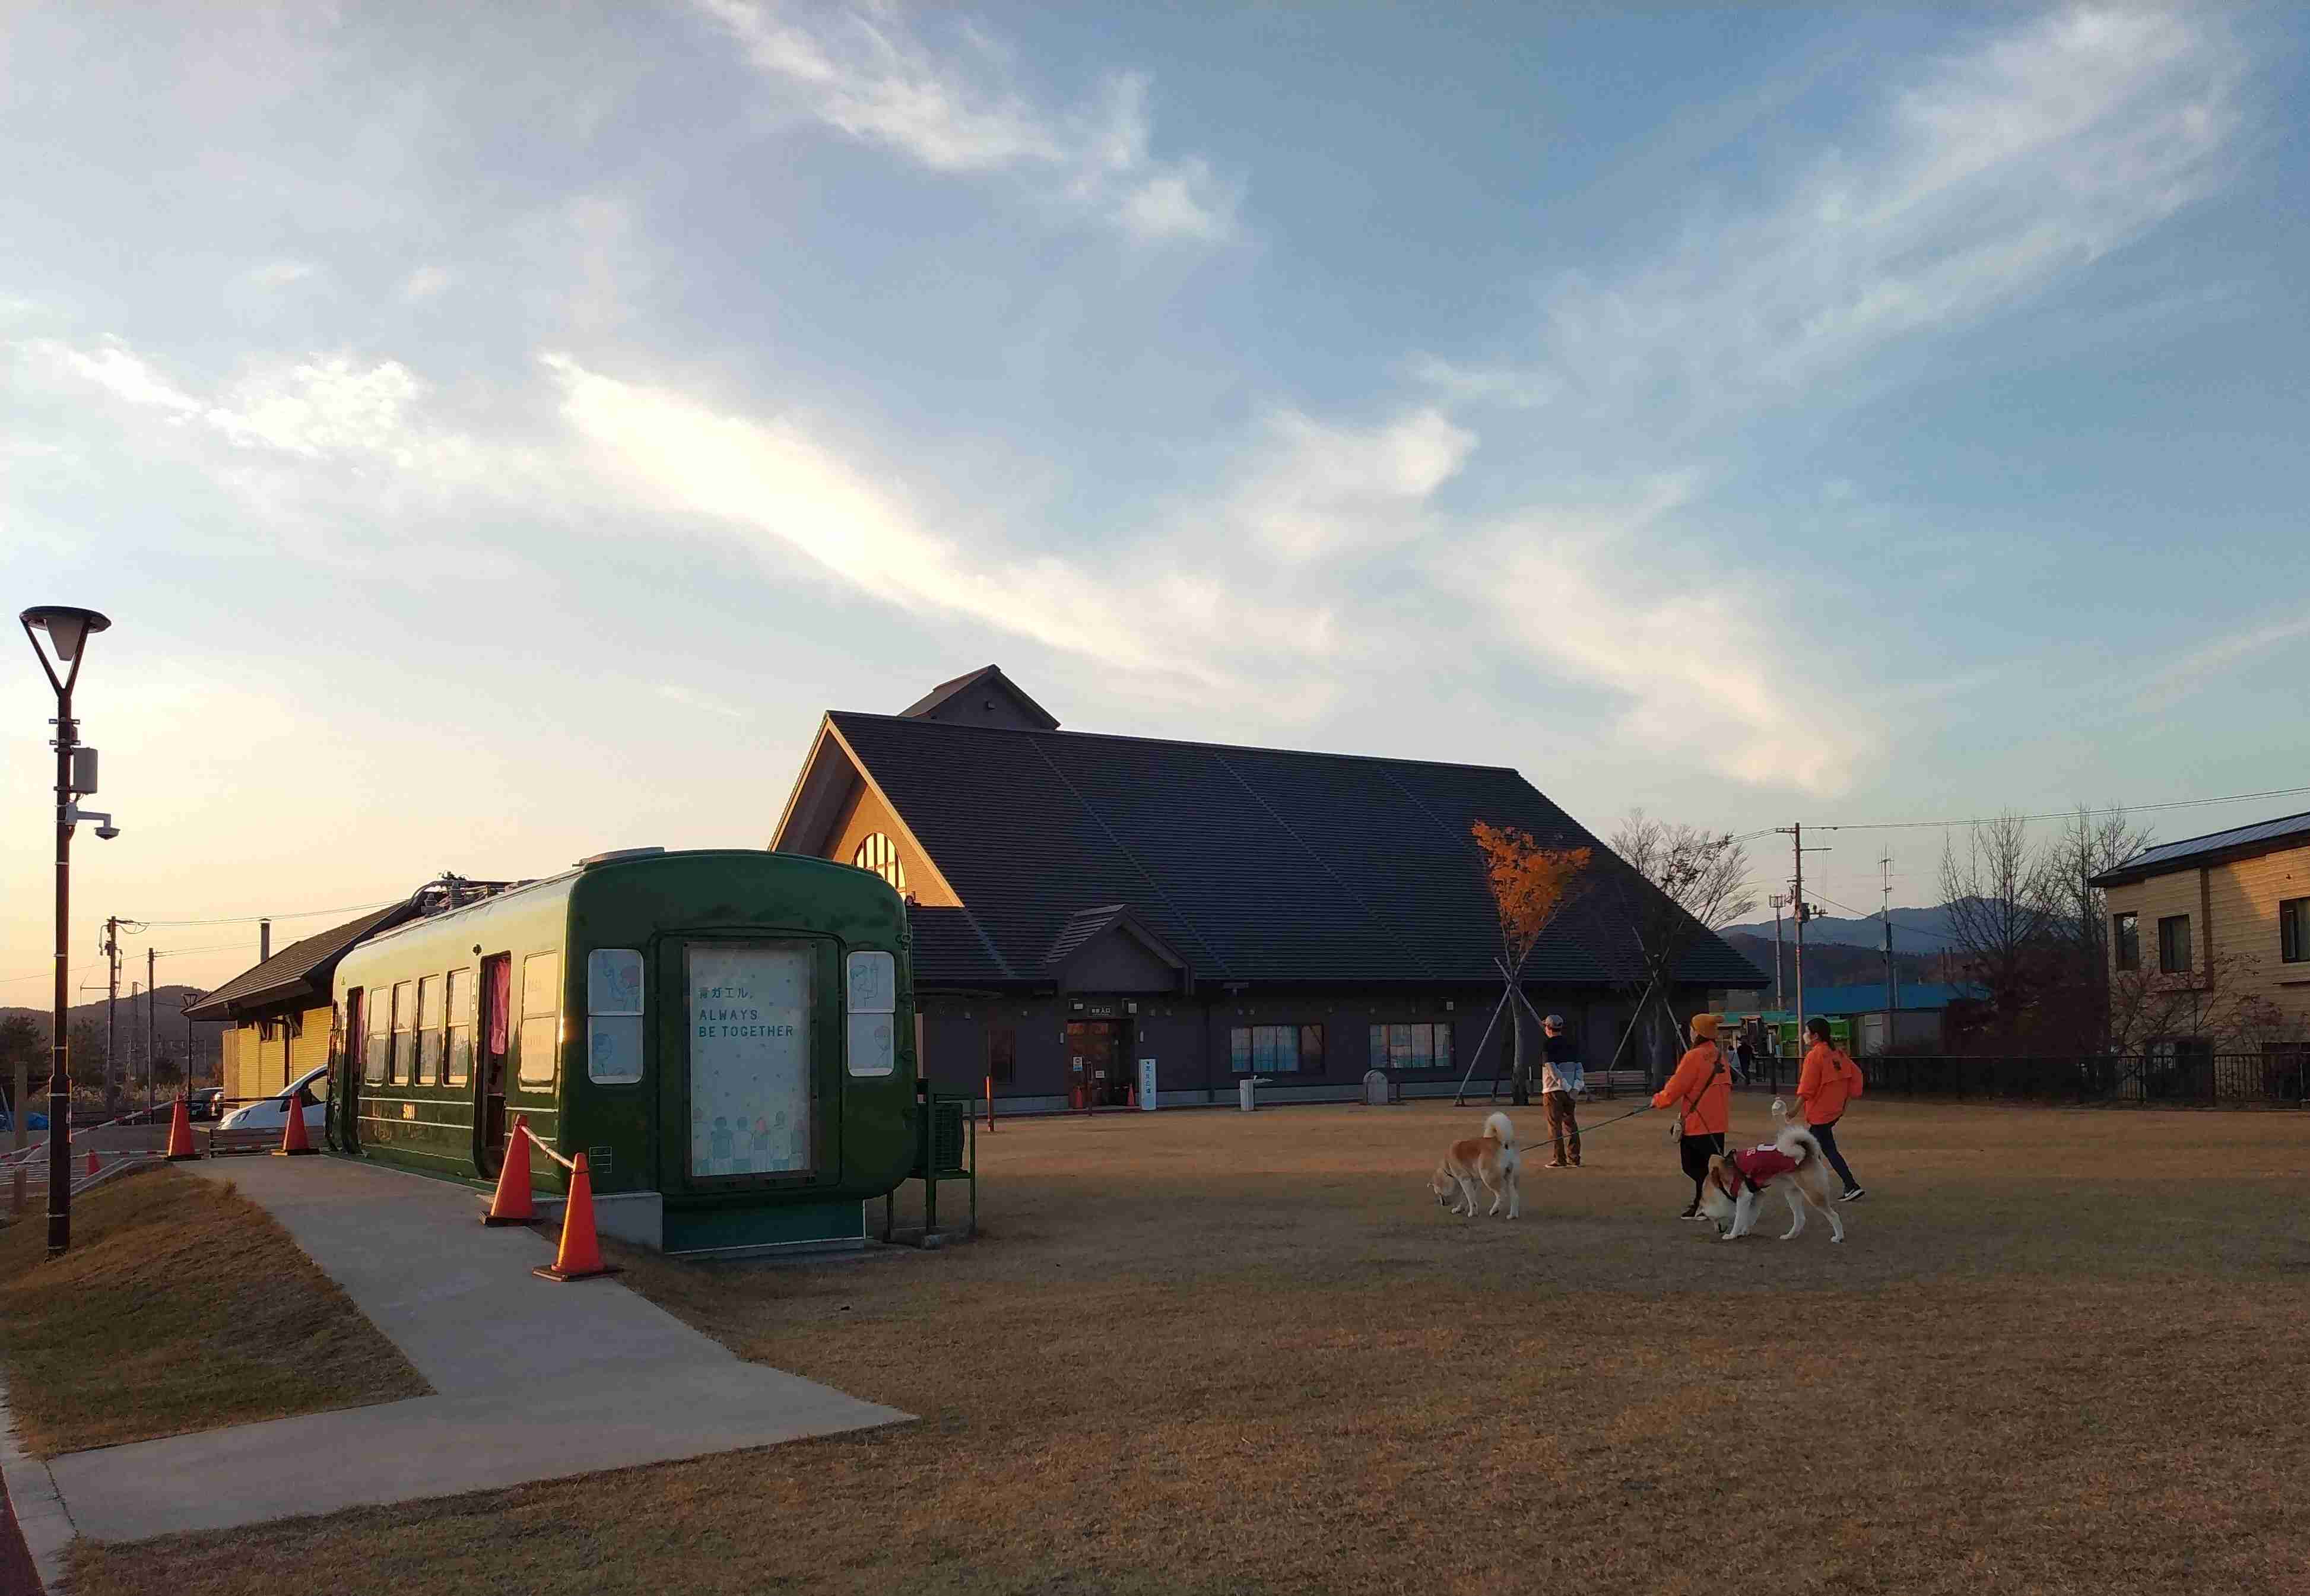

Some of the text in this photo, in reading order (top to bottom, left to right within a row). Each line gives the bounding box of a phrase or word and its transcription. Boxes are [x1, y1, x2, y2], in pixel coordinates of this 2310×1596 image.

[699, 1009, 759, 1021] ALWAYS
[699, 1026, 794, 1037] BE TOGETHER
